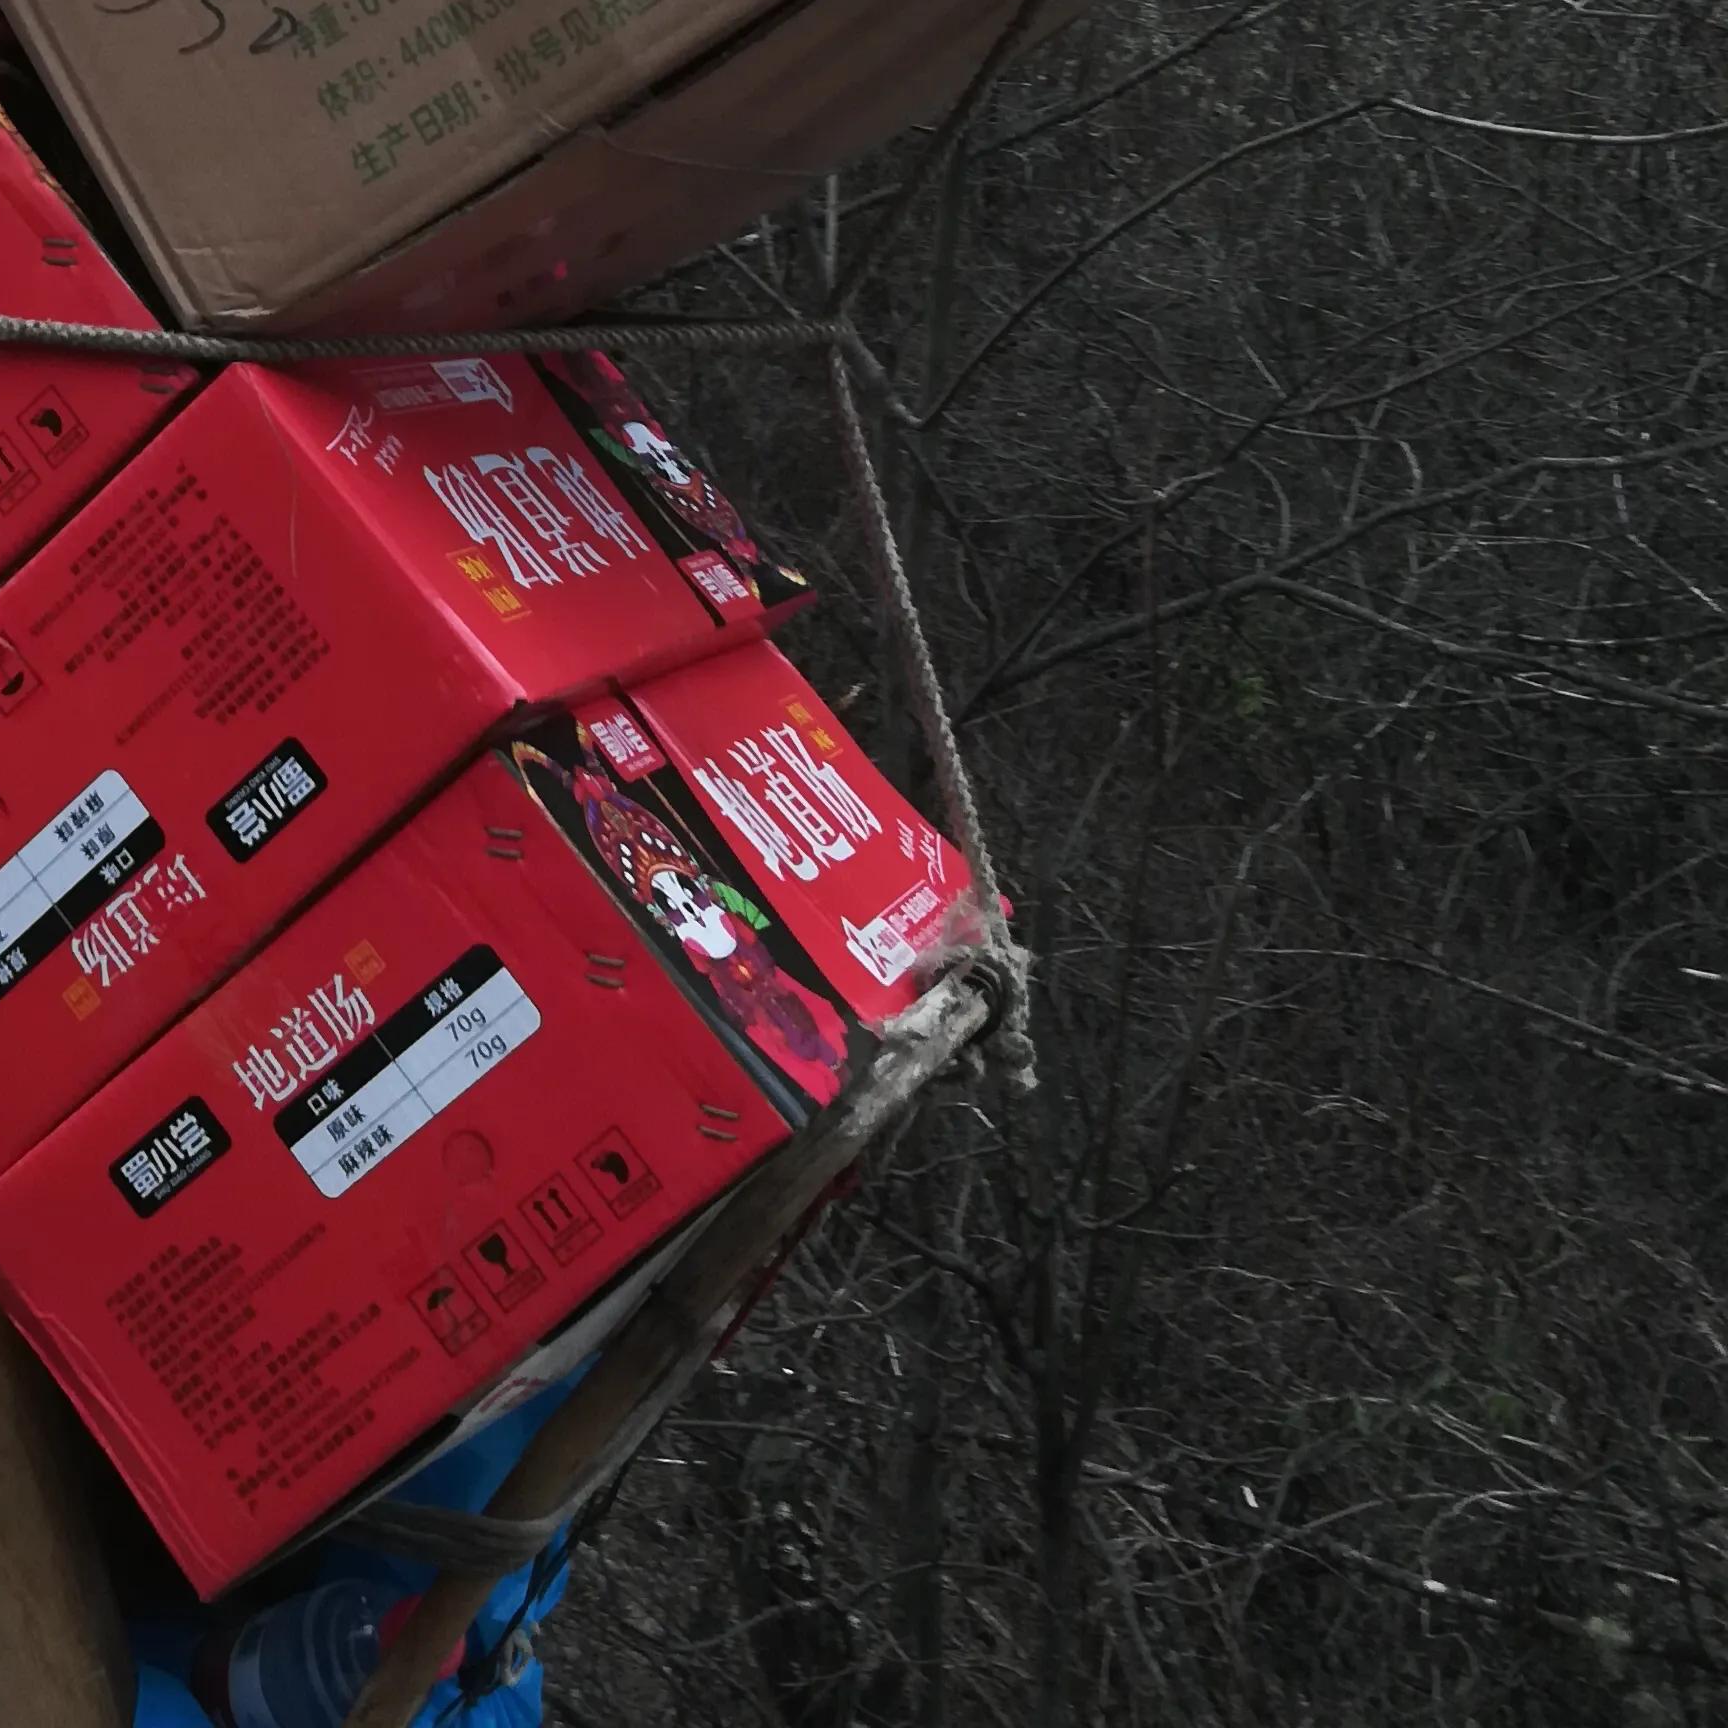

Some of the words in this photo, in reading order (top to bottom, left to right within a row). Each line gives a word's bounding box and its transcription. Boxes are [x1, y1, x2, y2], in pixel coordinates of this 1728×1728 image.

[422, 449, 649, 590] 地道肠
[50, 789, 106, 844] 麻辣味
[77, 822, 115, 862] 原味
[95, 847, 134, 886] 口味
[224, 755, 316, 846] 蜀小尝
[691, 724, 880, 881] 地道肠
[231, 973, 378, 1112] 地道肠
[305, 1075, 346, 1116] 口味
[422, 975, 464, 1017] 规格
[326, 1102, 368, 1143] 原味
[445, 1005, 488, 1042] 70g
[337, 1123, 395, 1178] 麻辣味
[464, 1032, 508, 1069] 70g
[120, 1110, 212, 1198] 蜀小尝
